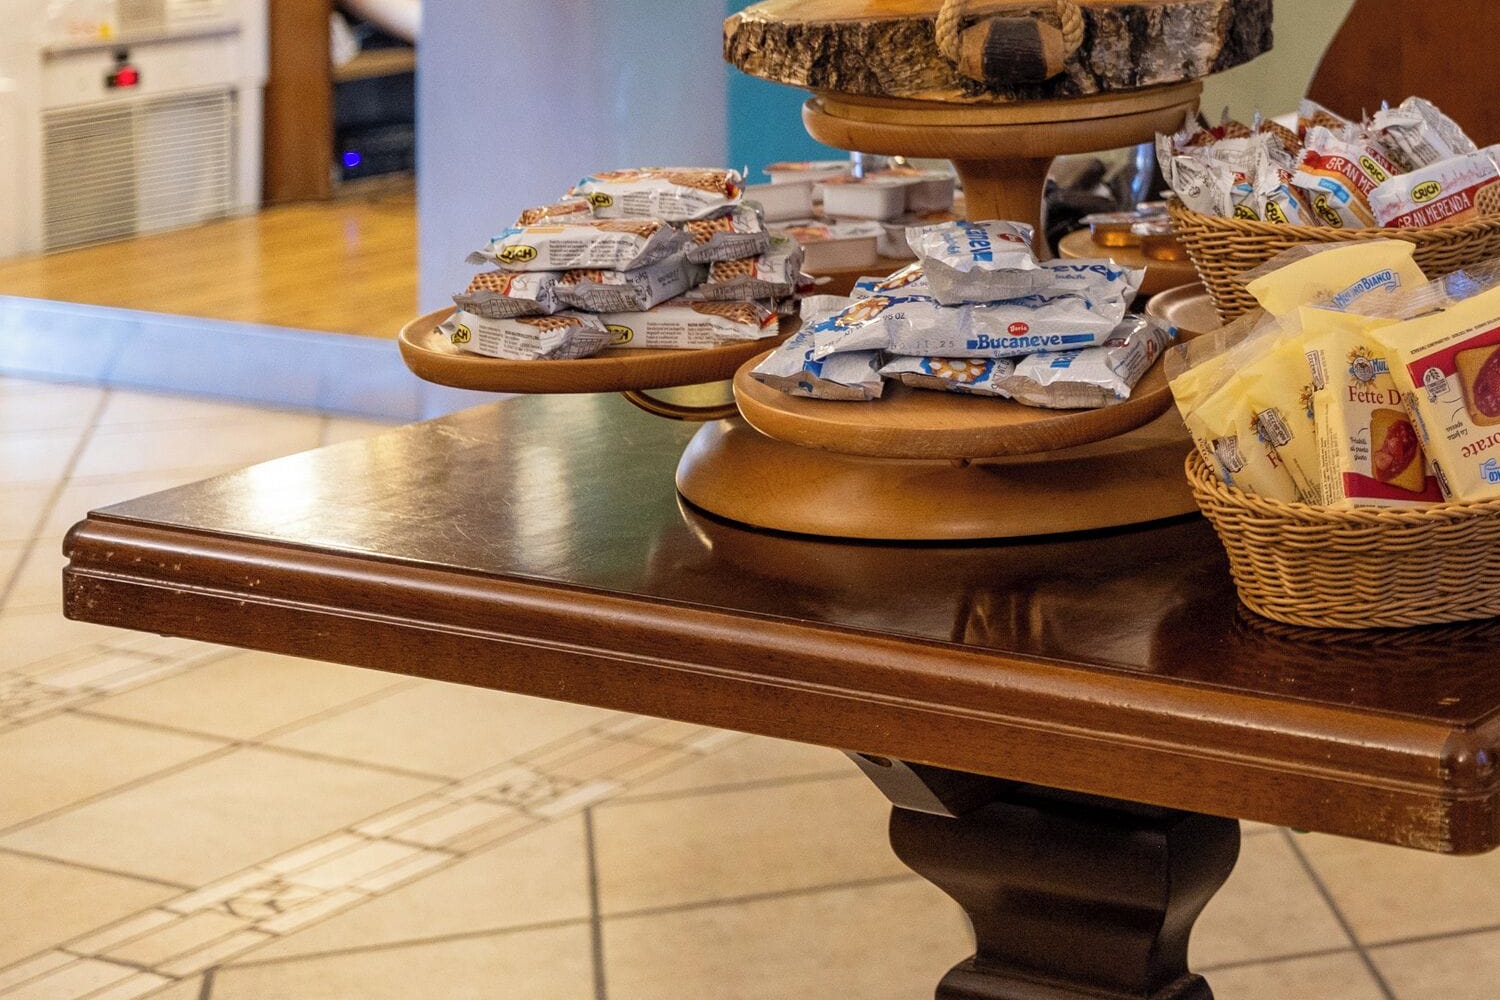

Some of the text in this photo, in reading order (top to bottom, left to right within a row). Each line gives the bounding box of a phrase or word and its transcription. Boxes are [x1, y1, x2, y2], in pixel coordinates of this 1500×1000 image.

[1326, 157, 1358, 182] GRAN
[1413, 183, 1438, 199] CRICH
[1398, 212, 1428, 228] GRAN
[1426, 193, 1471, 225] MERENDA
[1361, 271, 1392, 289] BIANCO
[977, 335, 1061, 349] Bucaneve
[1348, 385, 1402, 406] Fette D
